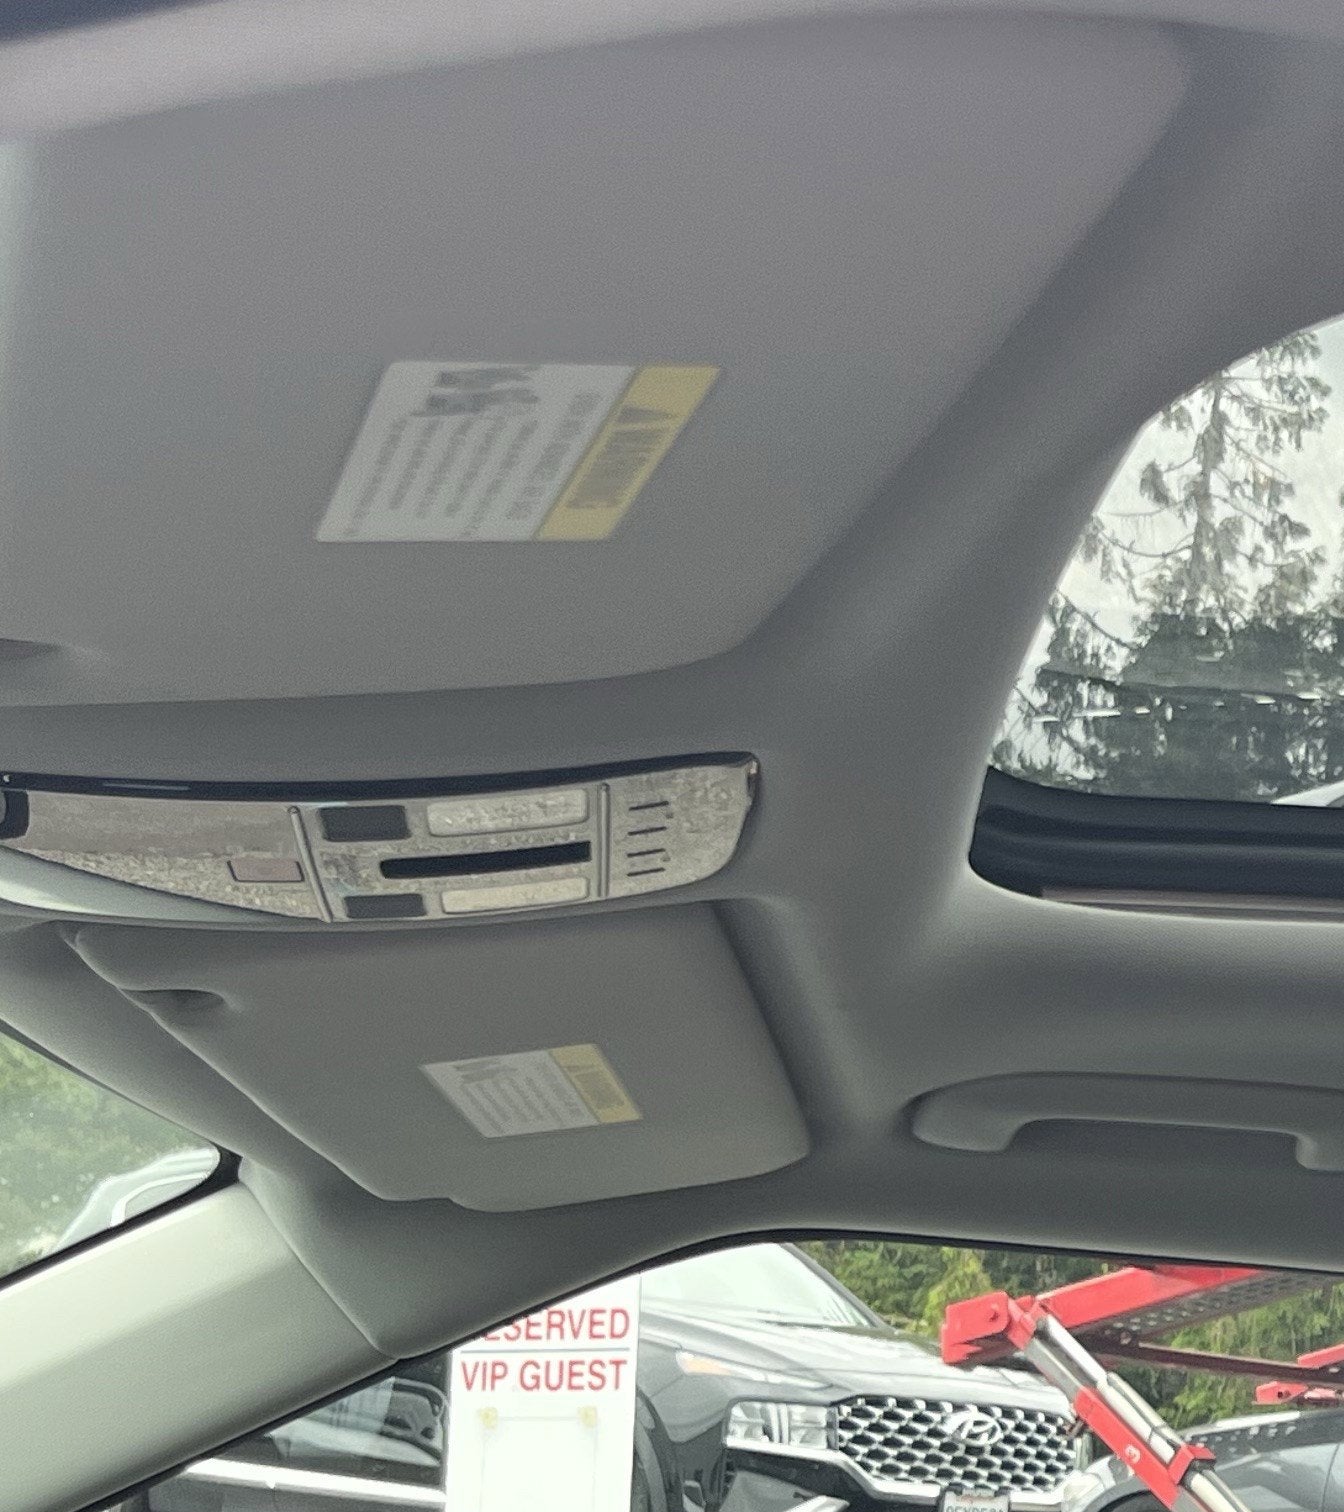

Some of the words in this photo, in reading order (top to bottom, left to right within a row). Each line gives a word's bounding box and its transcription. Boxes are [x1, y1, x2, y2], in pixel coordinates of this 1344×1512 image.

[483, 1307, 630, 1341] SERVED
[461, 1360, 508, 1391] VIP
[519, 1359, 628, 1391] GUEST
